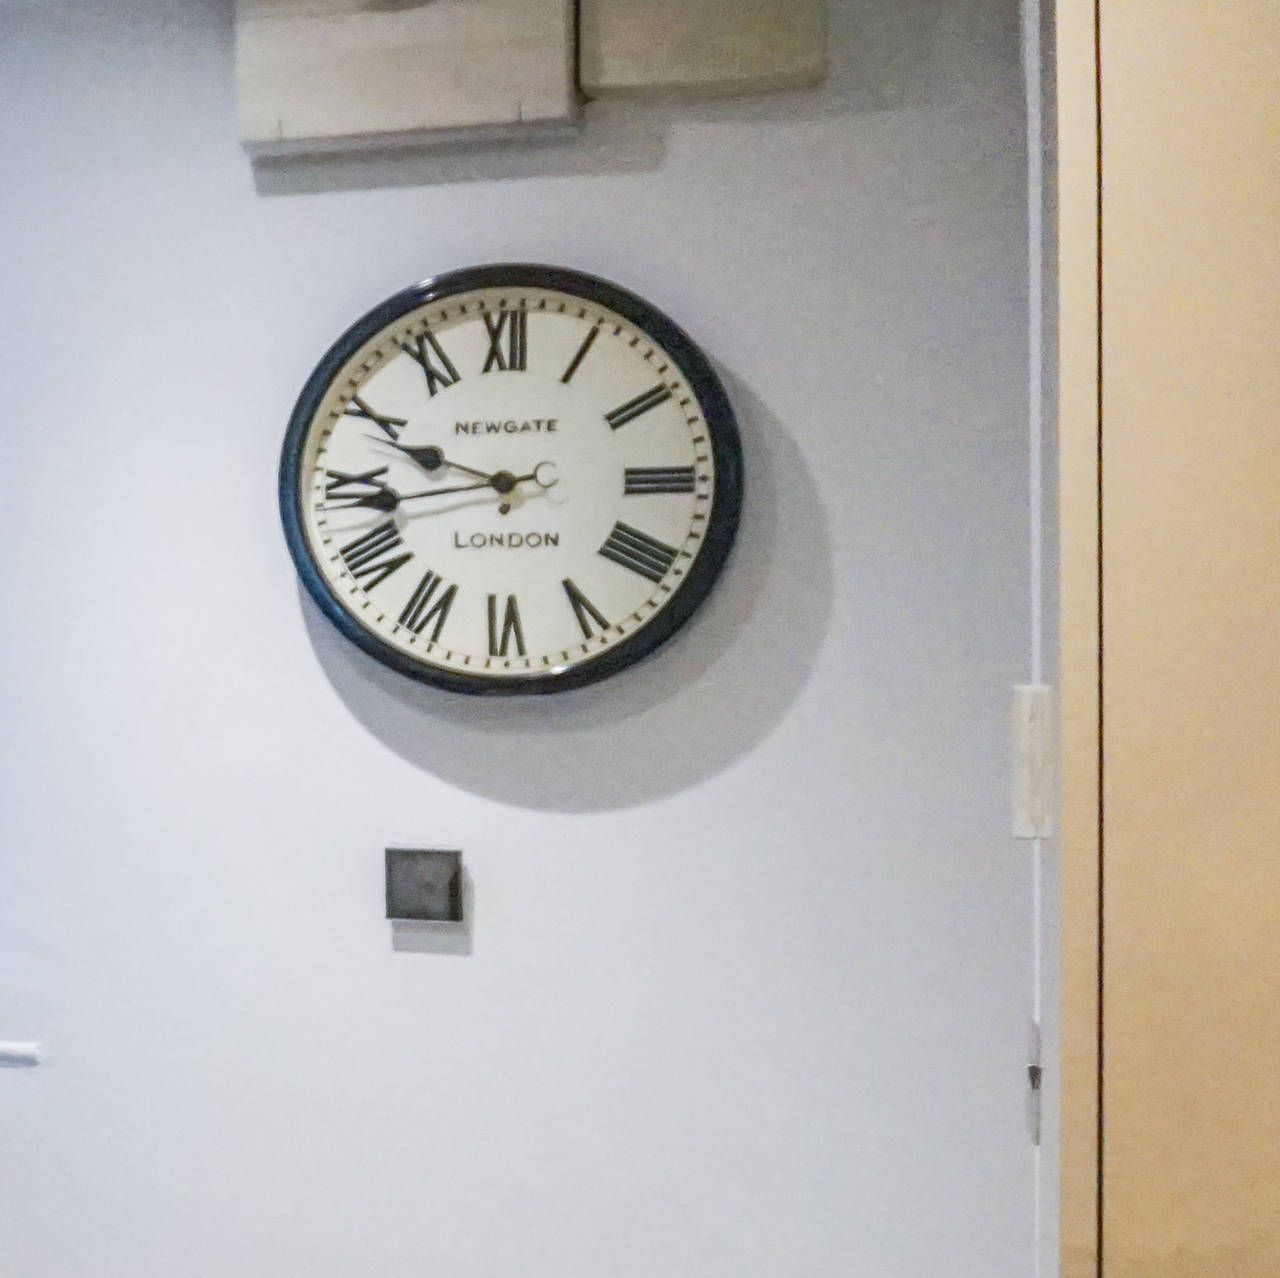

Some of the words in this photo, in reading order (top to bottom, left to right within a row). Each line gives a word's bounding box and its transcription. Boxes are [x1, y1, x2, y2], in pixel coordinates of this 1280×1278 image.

[401, 328, 462, 397] XI
[482, 310, 528, 374] XII
[343, 395, 408, 441] X
[455, 419, 559, 434] NEWGATE
[604, 382, 673, 430] II
[624, 466, 696, 495] III
[339, 519, 415, 593] VIII
[454, 532, 559, 548] LONDON
[398, 569, 459, 643] VII
[487, 594, 527, 656] VI
[562, 578, 611, 639] V
